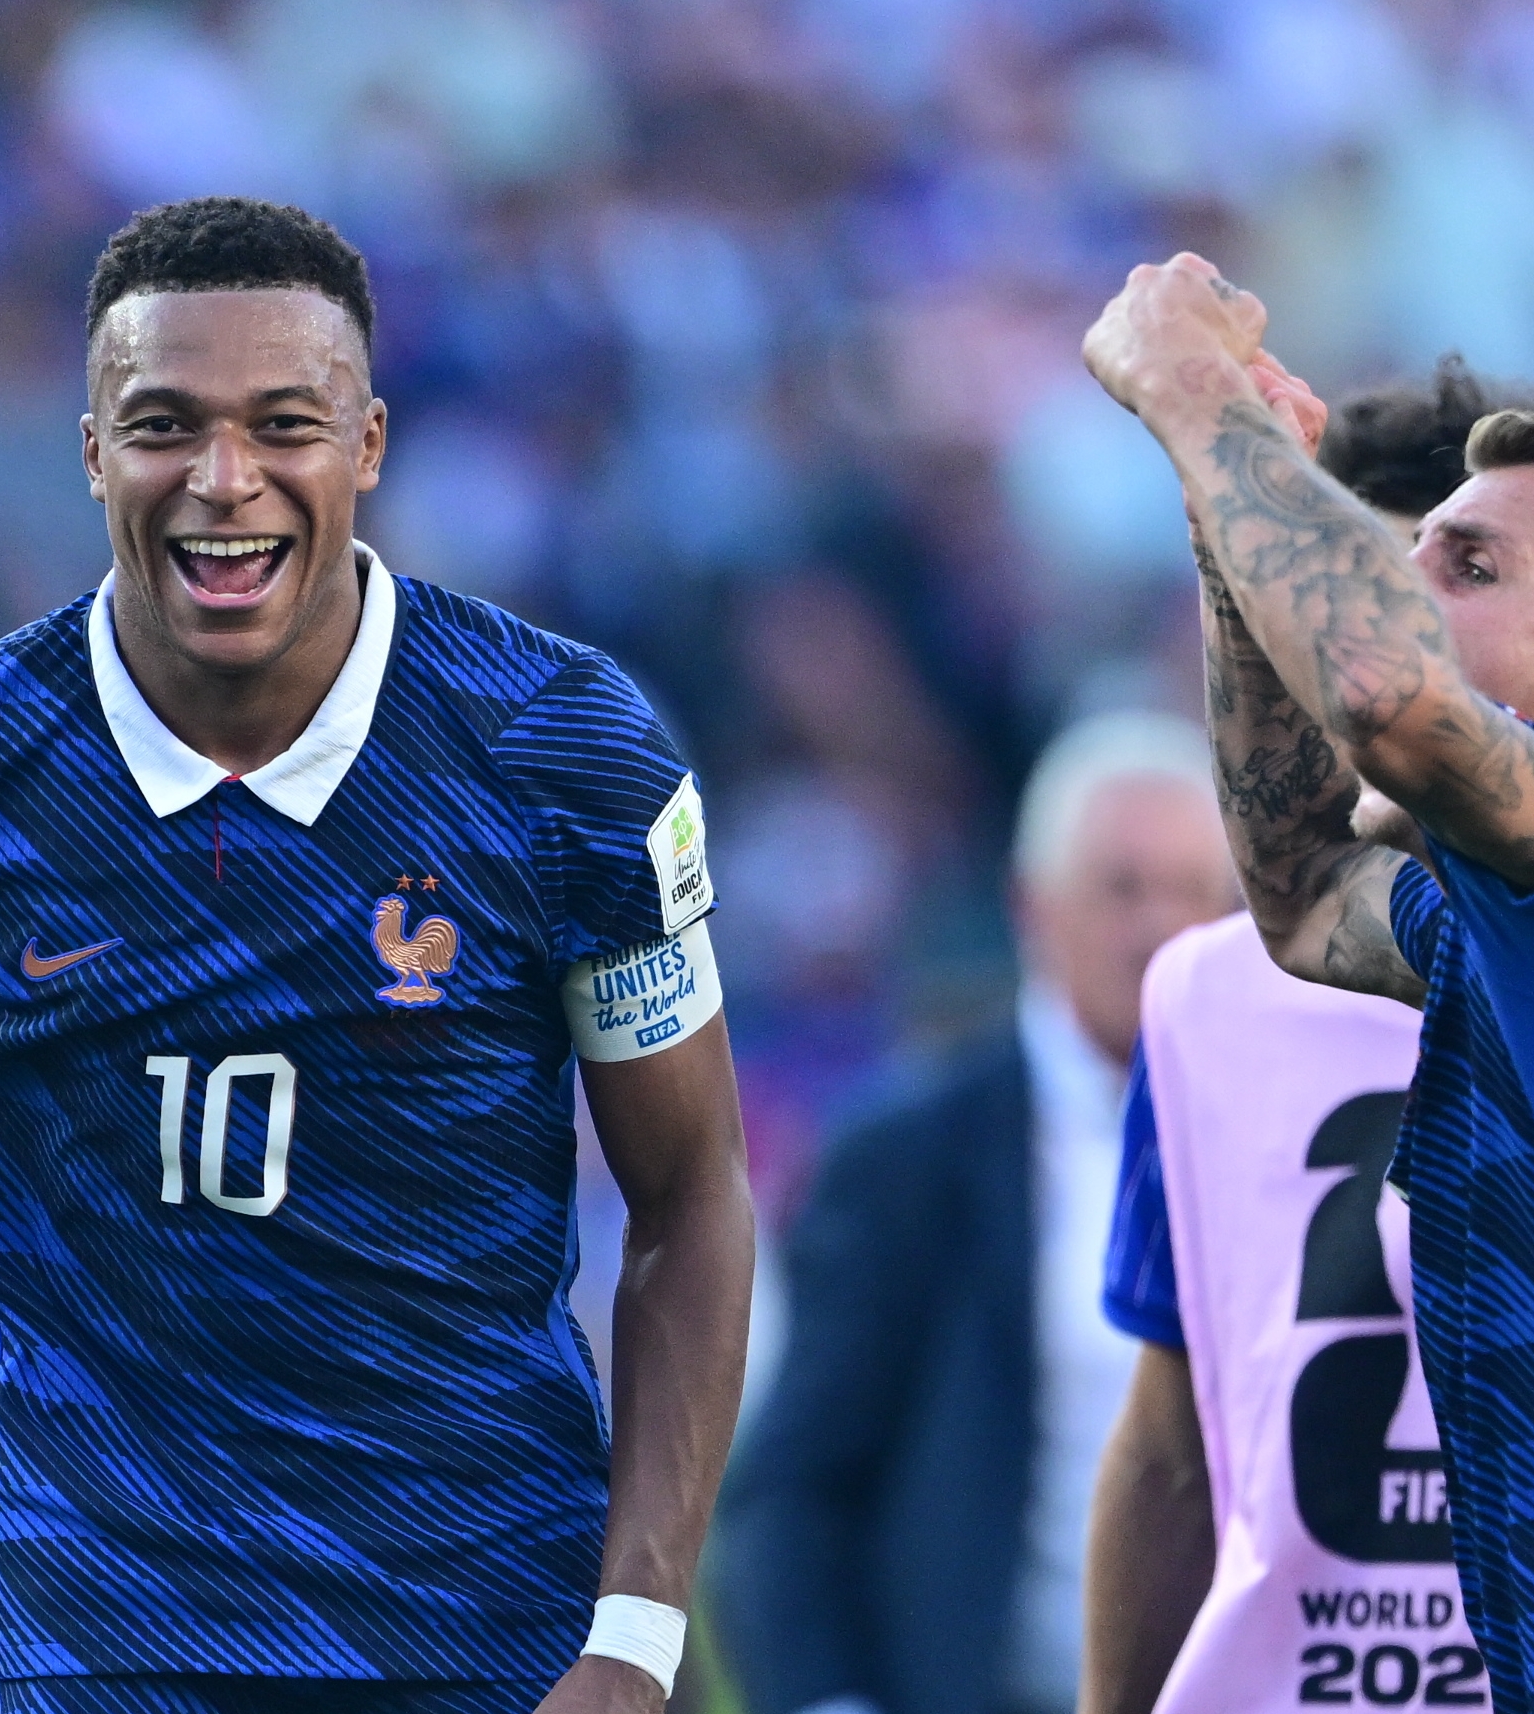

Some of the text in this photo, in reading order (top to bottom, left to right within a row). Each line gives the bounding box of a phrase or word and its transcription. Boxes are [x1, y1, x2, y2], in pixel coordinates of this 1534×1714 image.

[671, 858, 705, 905] EDUCA
[592, 966, 695, 1031] the World
[593, 940, 685, 1005] UNITES
[640, 1021, 678, 1045] FIFA
[146, 1052, 299, 1217] 10
[1379, 1470, 1452, 1524] FIF
[1300, 1588, 1454, 1629] WORLD
[1299, 1643, 1487, 1706] 202
